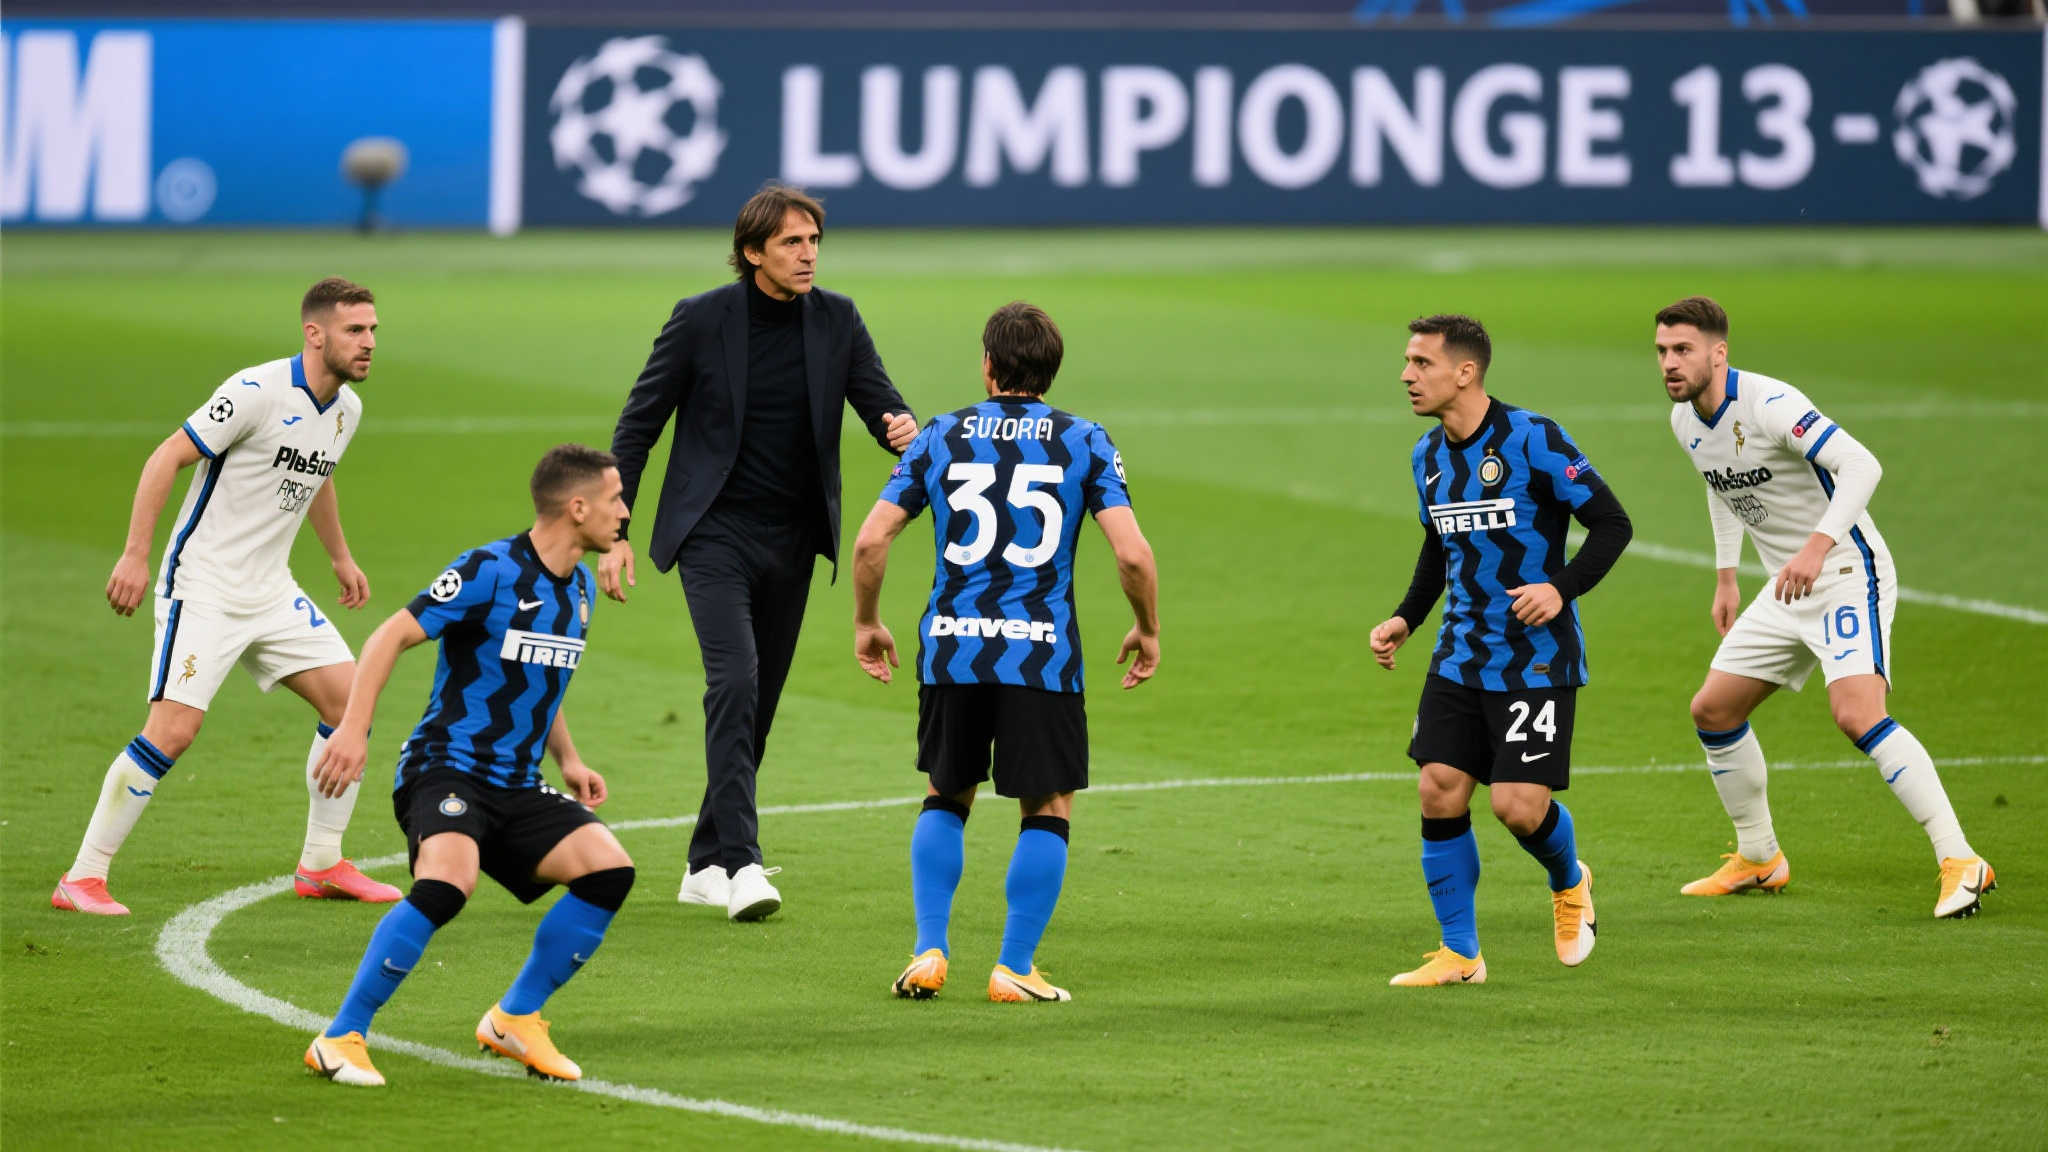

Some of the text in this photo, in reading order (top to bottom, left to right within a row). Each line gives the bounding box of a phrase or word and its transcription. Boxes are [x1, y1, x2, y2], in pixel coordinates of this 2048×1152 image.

[780, 64, 1632, 189] LUMPIONGE
[1669, 64, 1815, 190] 13
[944, 463, 1064, 568] 35
[1824, 605, 1860, 645] 16
[1505, 700, 1557, 743] 24
